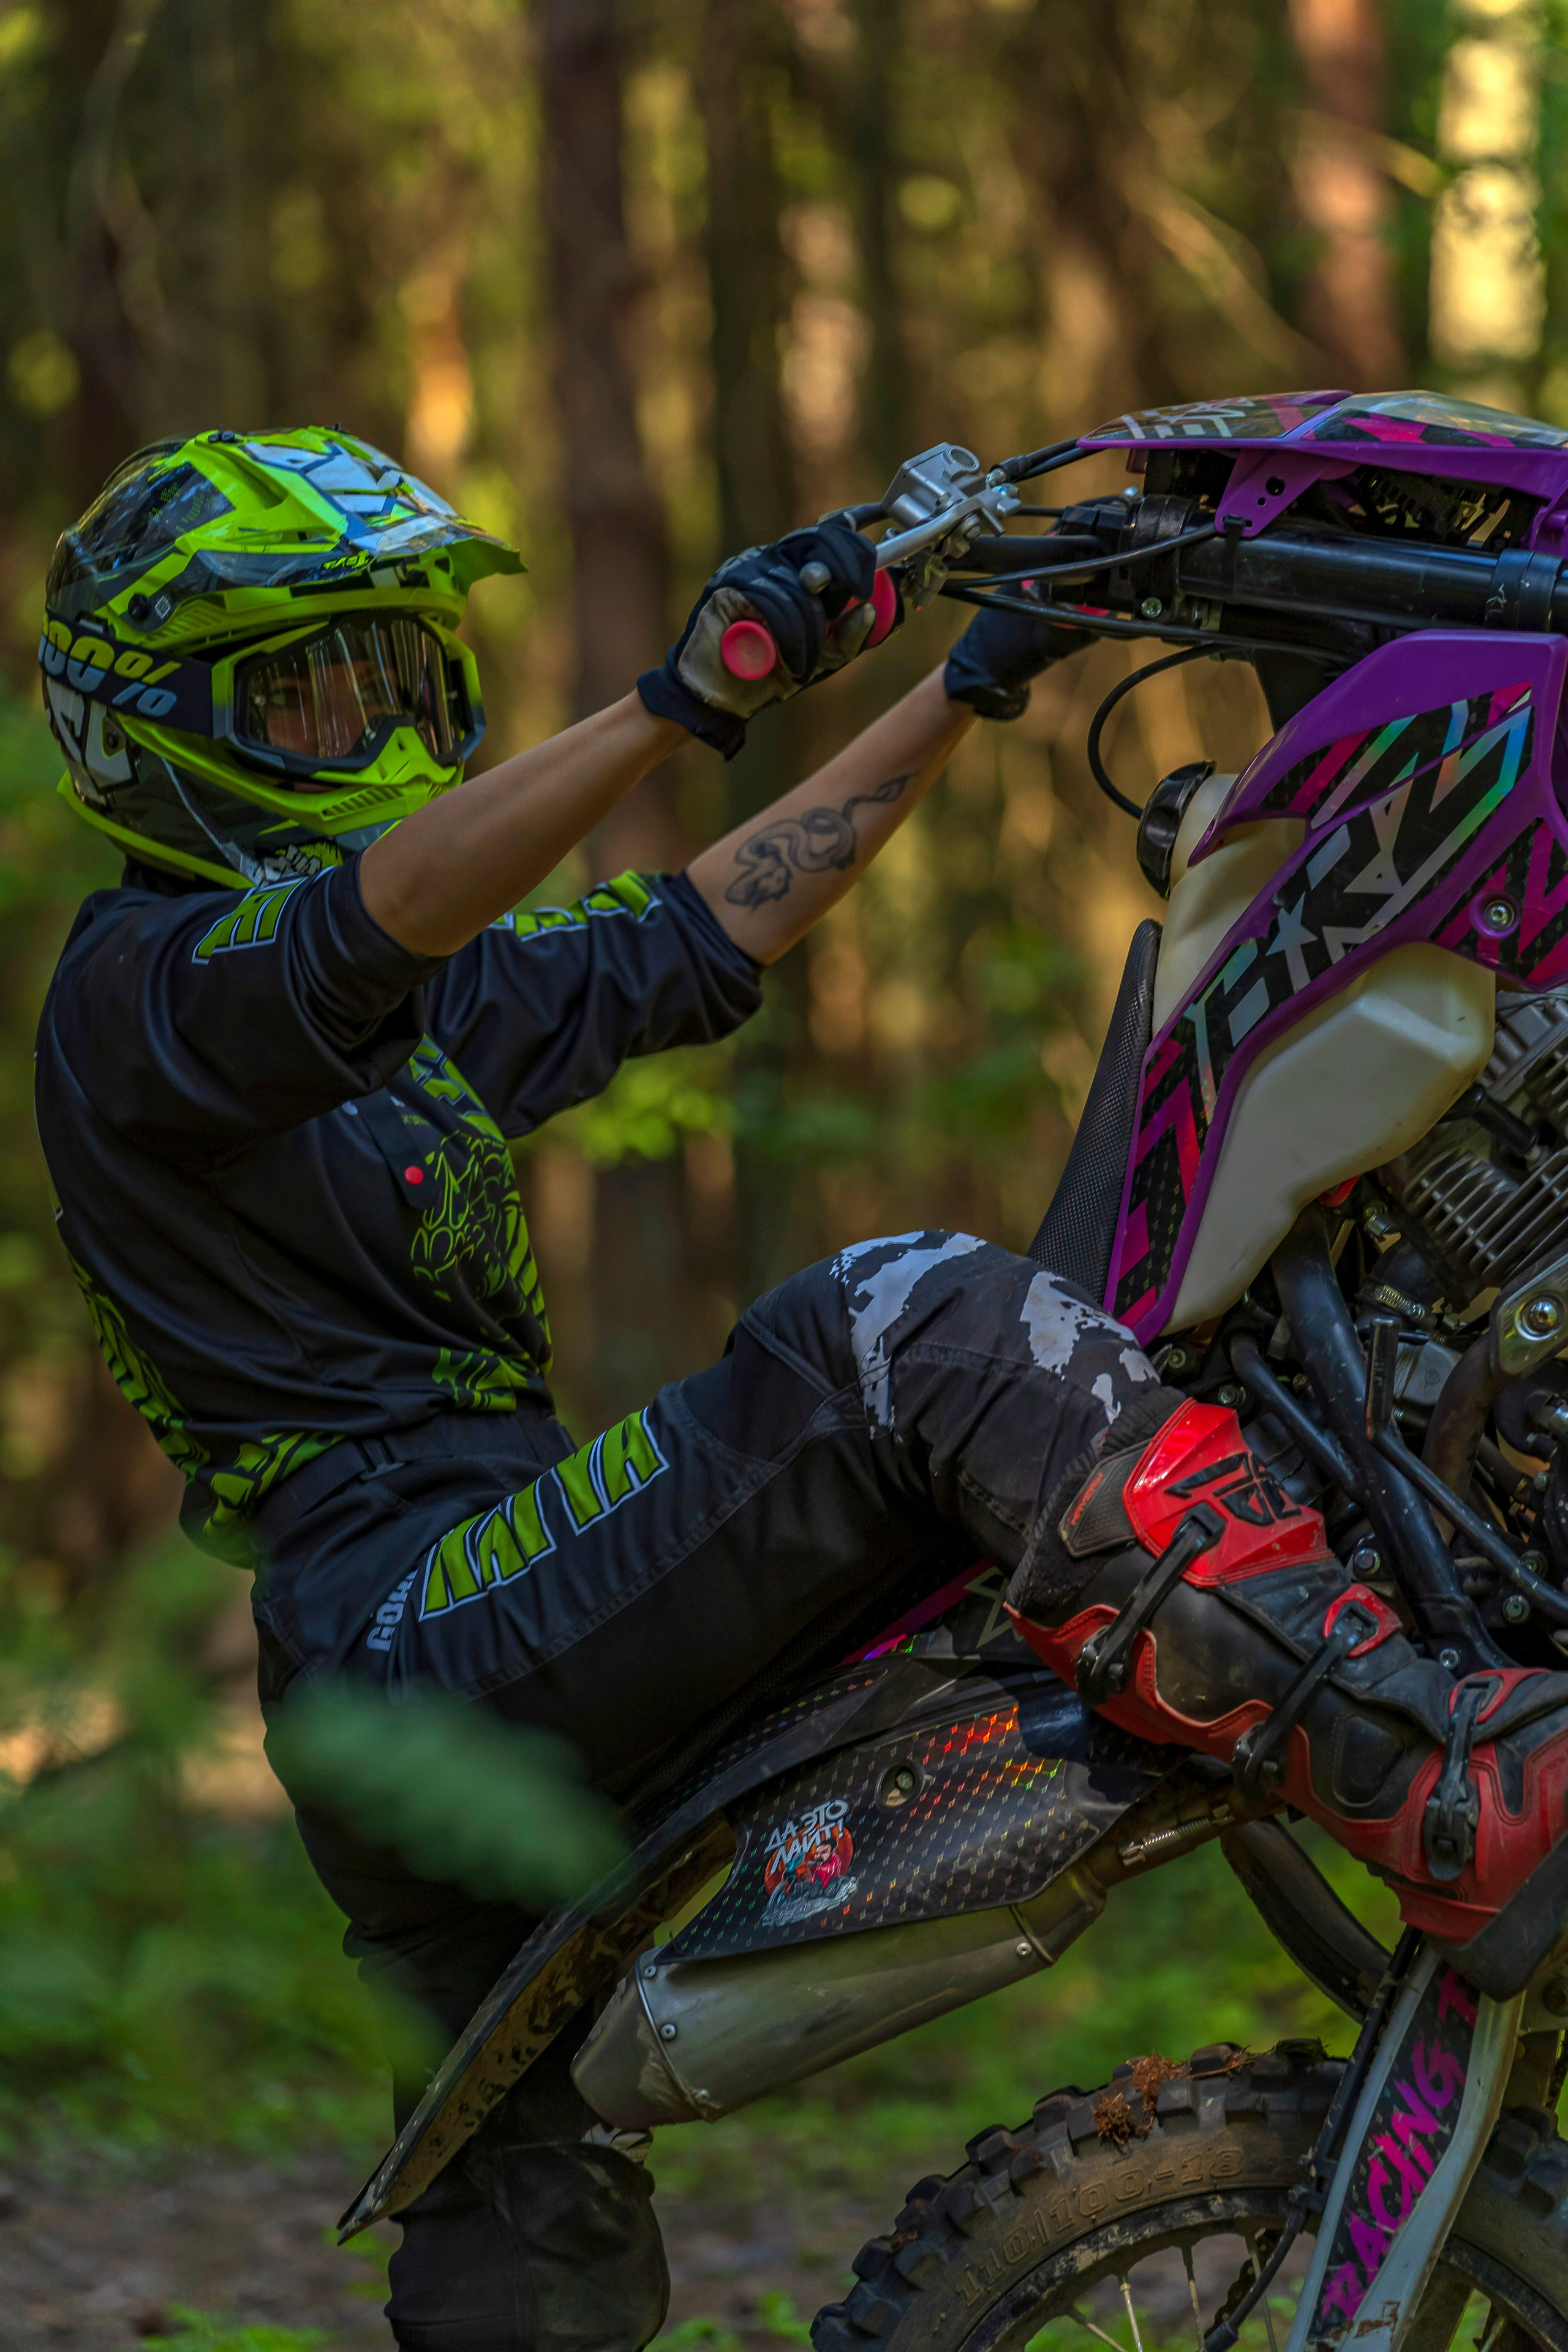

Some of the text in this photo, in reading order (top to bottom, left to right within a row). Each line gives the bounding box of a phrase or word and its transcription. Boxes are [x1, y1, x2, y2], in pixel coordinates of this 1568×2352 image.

[764, 1799, 850, 1854] ДА ЭТО
[1321, 2040, 1466, 2324] RACING
